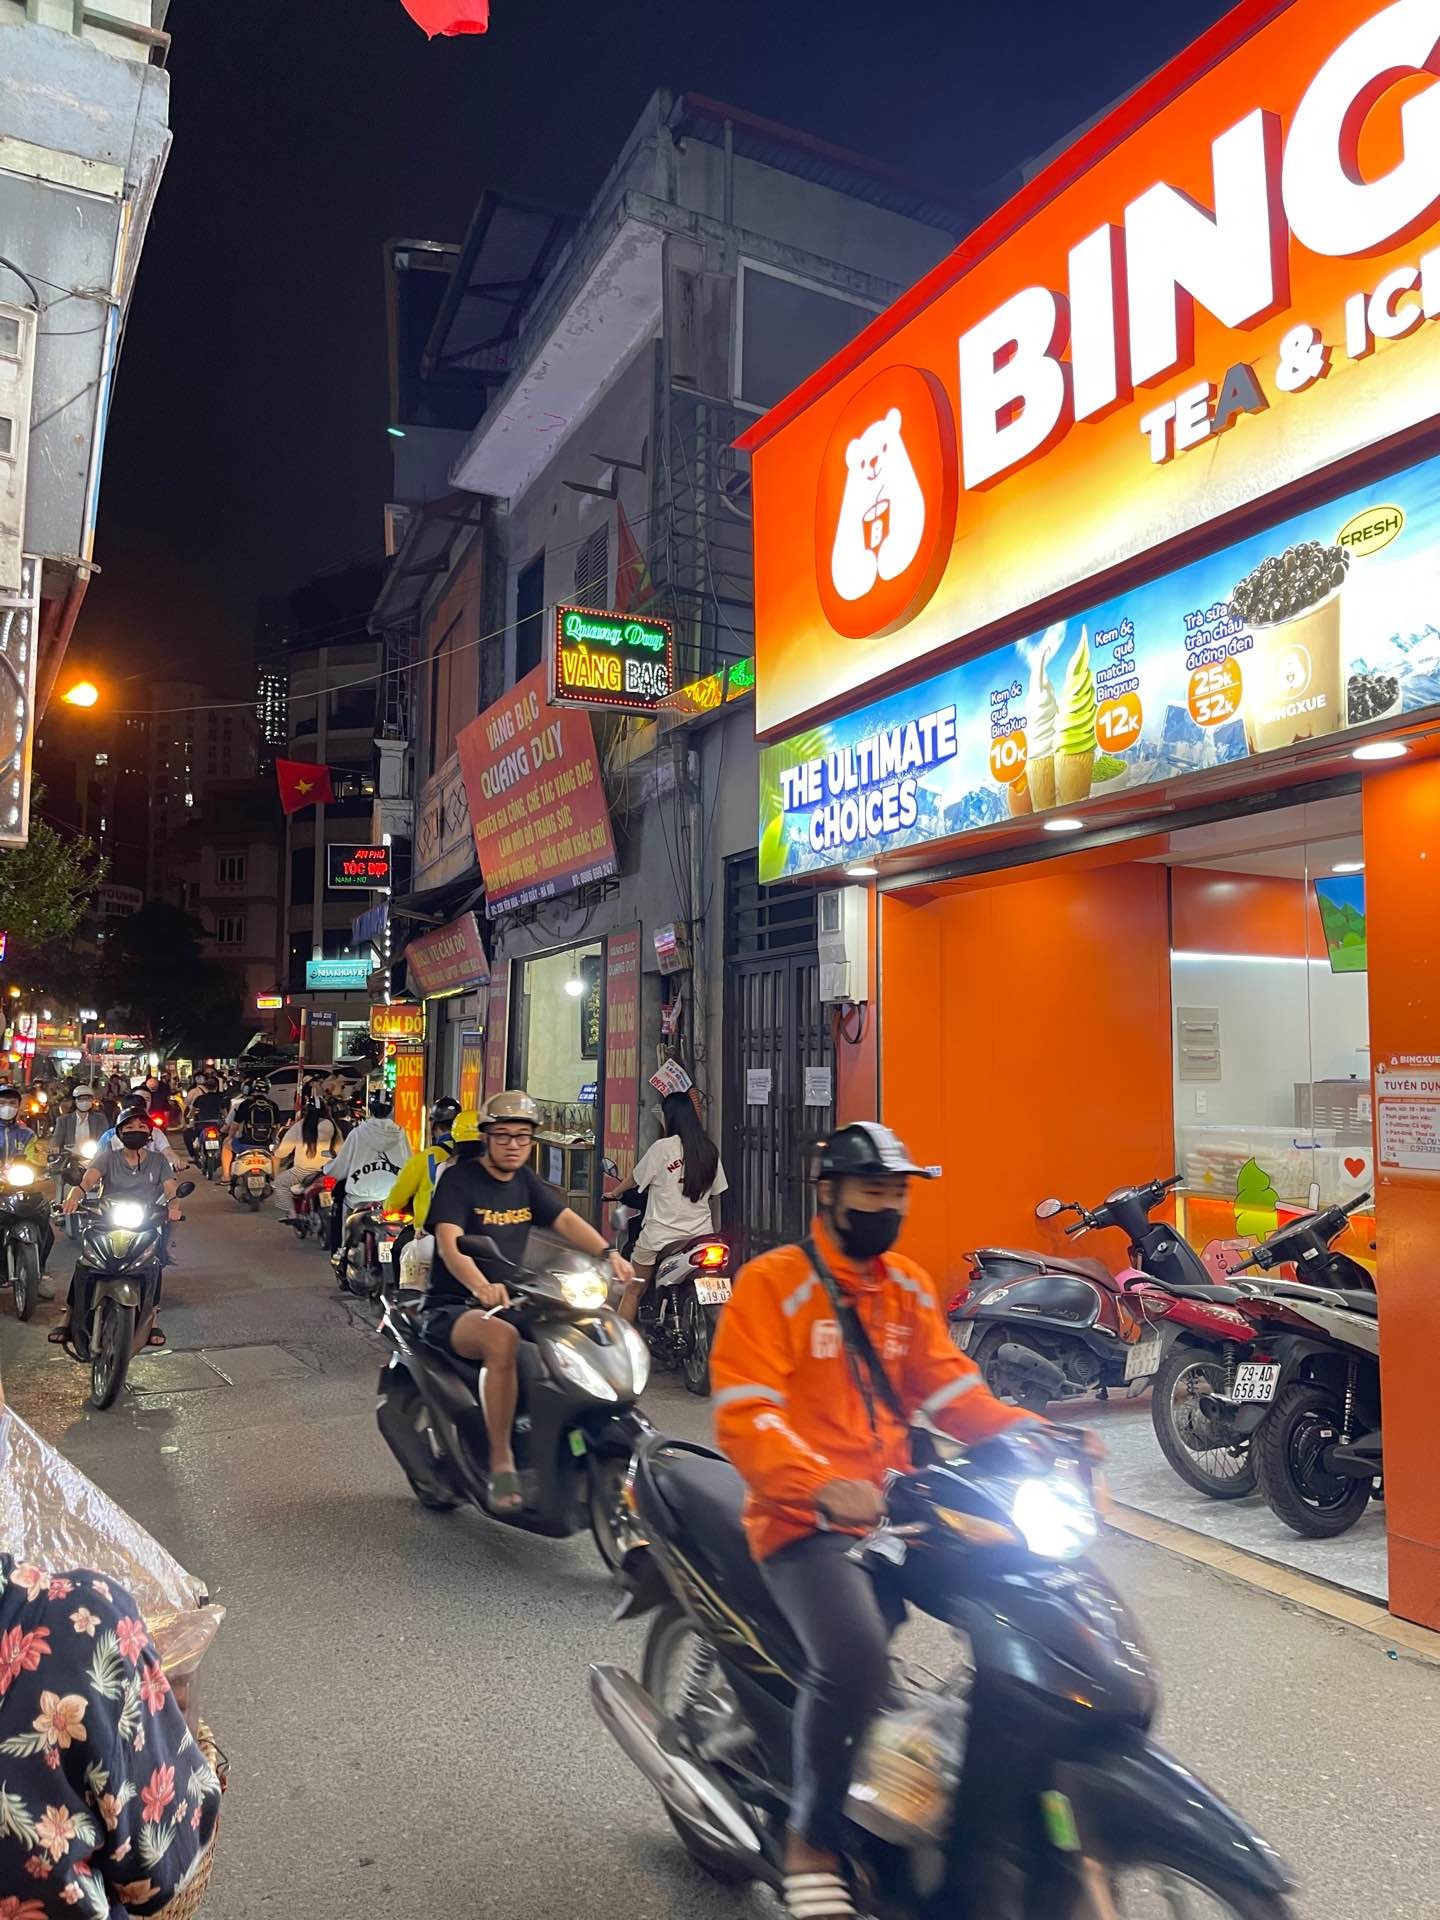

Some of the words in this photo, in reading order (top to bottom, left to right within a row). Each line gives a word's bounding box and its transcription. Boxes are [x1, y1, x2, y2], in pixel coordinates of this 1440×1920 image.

[1140, 361, 1268, 465] TEA
[1275, 323, 1331, 391] &
[1340, 515, 1399, 546] FRESH
[1184, 611, 1205, 631] Trà
[1206, 603, 1228, 623] sữa
[1095, 630, 1118, 648] Kem
[1119, 617, 1134, 636] ốc
[1185, 632, 1211, 652] trân
[1212, 618, 1243, 641] châu
[1186, 646, 1226, 671] đường
[1229, 635, 1253, 658] đen
[562, 645, 622, 692] VÀNG
[625, 658, 669, 701] BẠC
[1097, 659, 1135, 684] matcha
[991, 690, 1009, 706] Kem
[1097, 677, 1139, 702] Bingxue
[486, 707, 515, 752] VÀNG
[514, 691, 540, 731] BẠC
[480, 743, 530, 800] QUANG
[780, 758, 824, 812] THE
[827, 704, 957, 796] ULTIMATE
[809, 778, 918, 853] CHOICES
[344, 860, 366, 875] TÓC
[374, 1006, 401, 1033] CẦM
[405, 1006, 423, 1033] ĐỒ
[397, 1056, 424, 1083] DỊCH
[1400, 1055, 1440, 1064] BINGXUE
[400, 1091, 419, 1118] VỤ
[1241, 1366, 1273, 1383] 29-AD
[1234, 1383, 1272, 1400] 658.39
